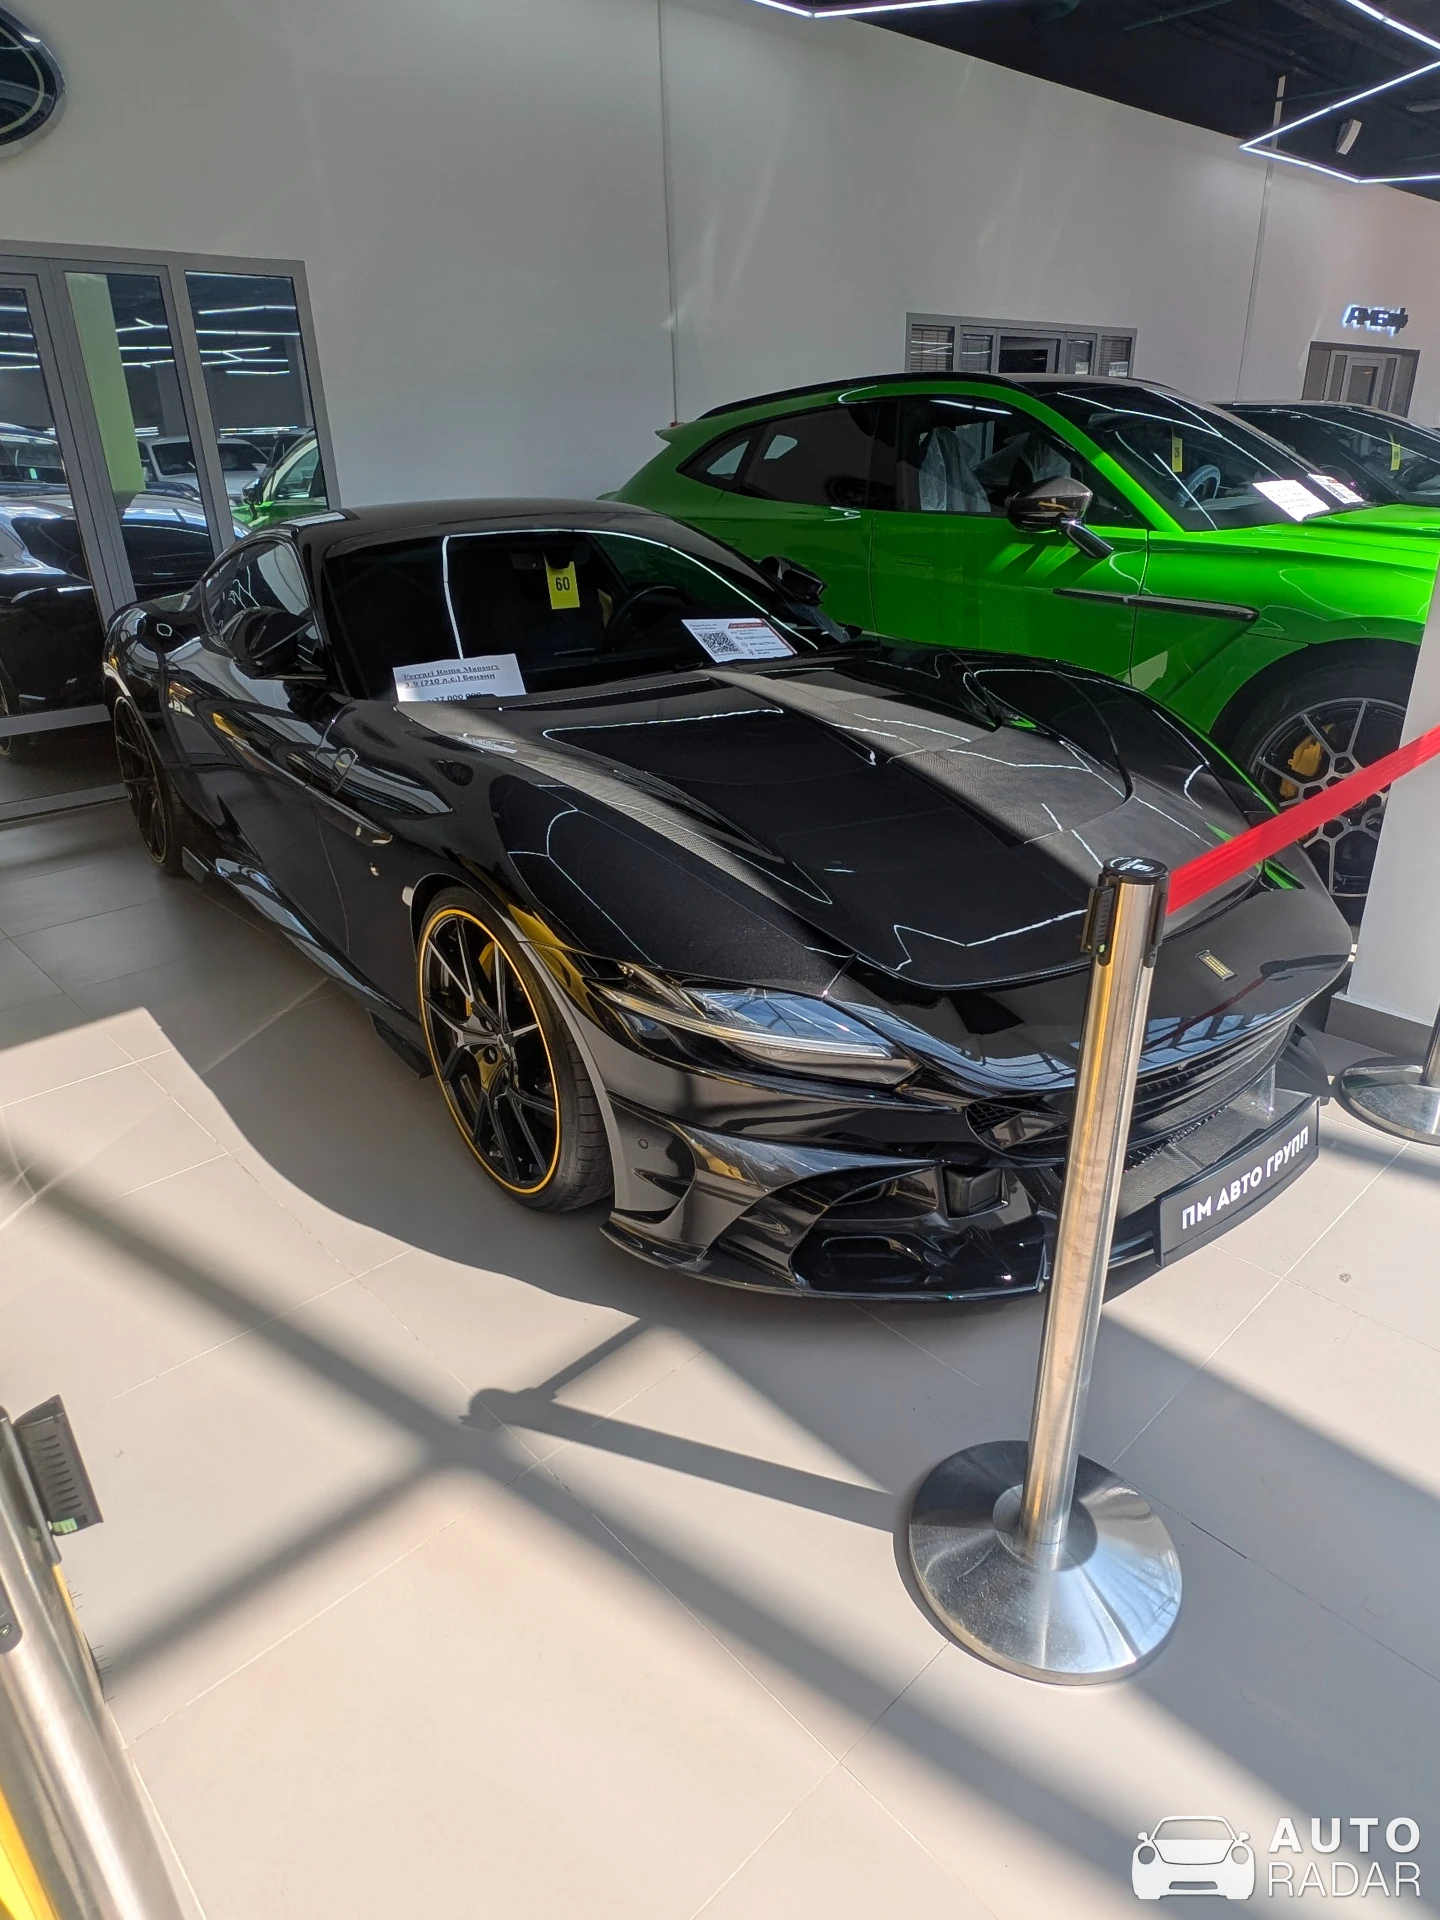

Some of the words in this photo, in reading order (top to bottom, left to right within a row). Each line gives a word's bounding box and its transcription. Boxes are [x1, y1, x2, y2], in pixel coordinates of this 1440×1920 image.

[555, 576, 570, 591] 60
[403, 671, 434, 680] Ferrari
[436, 668, 460, 676] Roma
[463, 664, 500, 673] Mansory
[420, 678, 440, 687] (710
[463, 673, 496, 681] Бензин
[1182, 1196, 1212, 1229] ПМ
[1217, 1166, 1263, 1211] АВТО
[1266, 1126, 1309, 1178] ГРУПП
